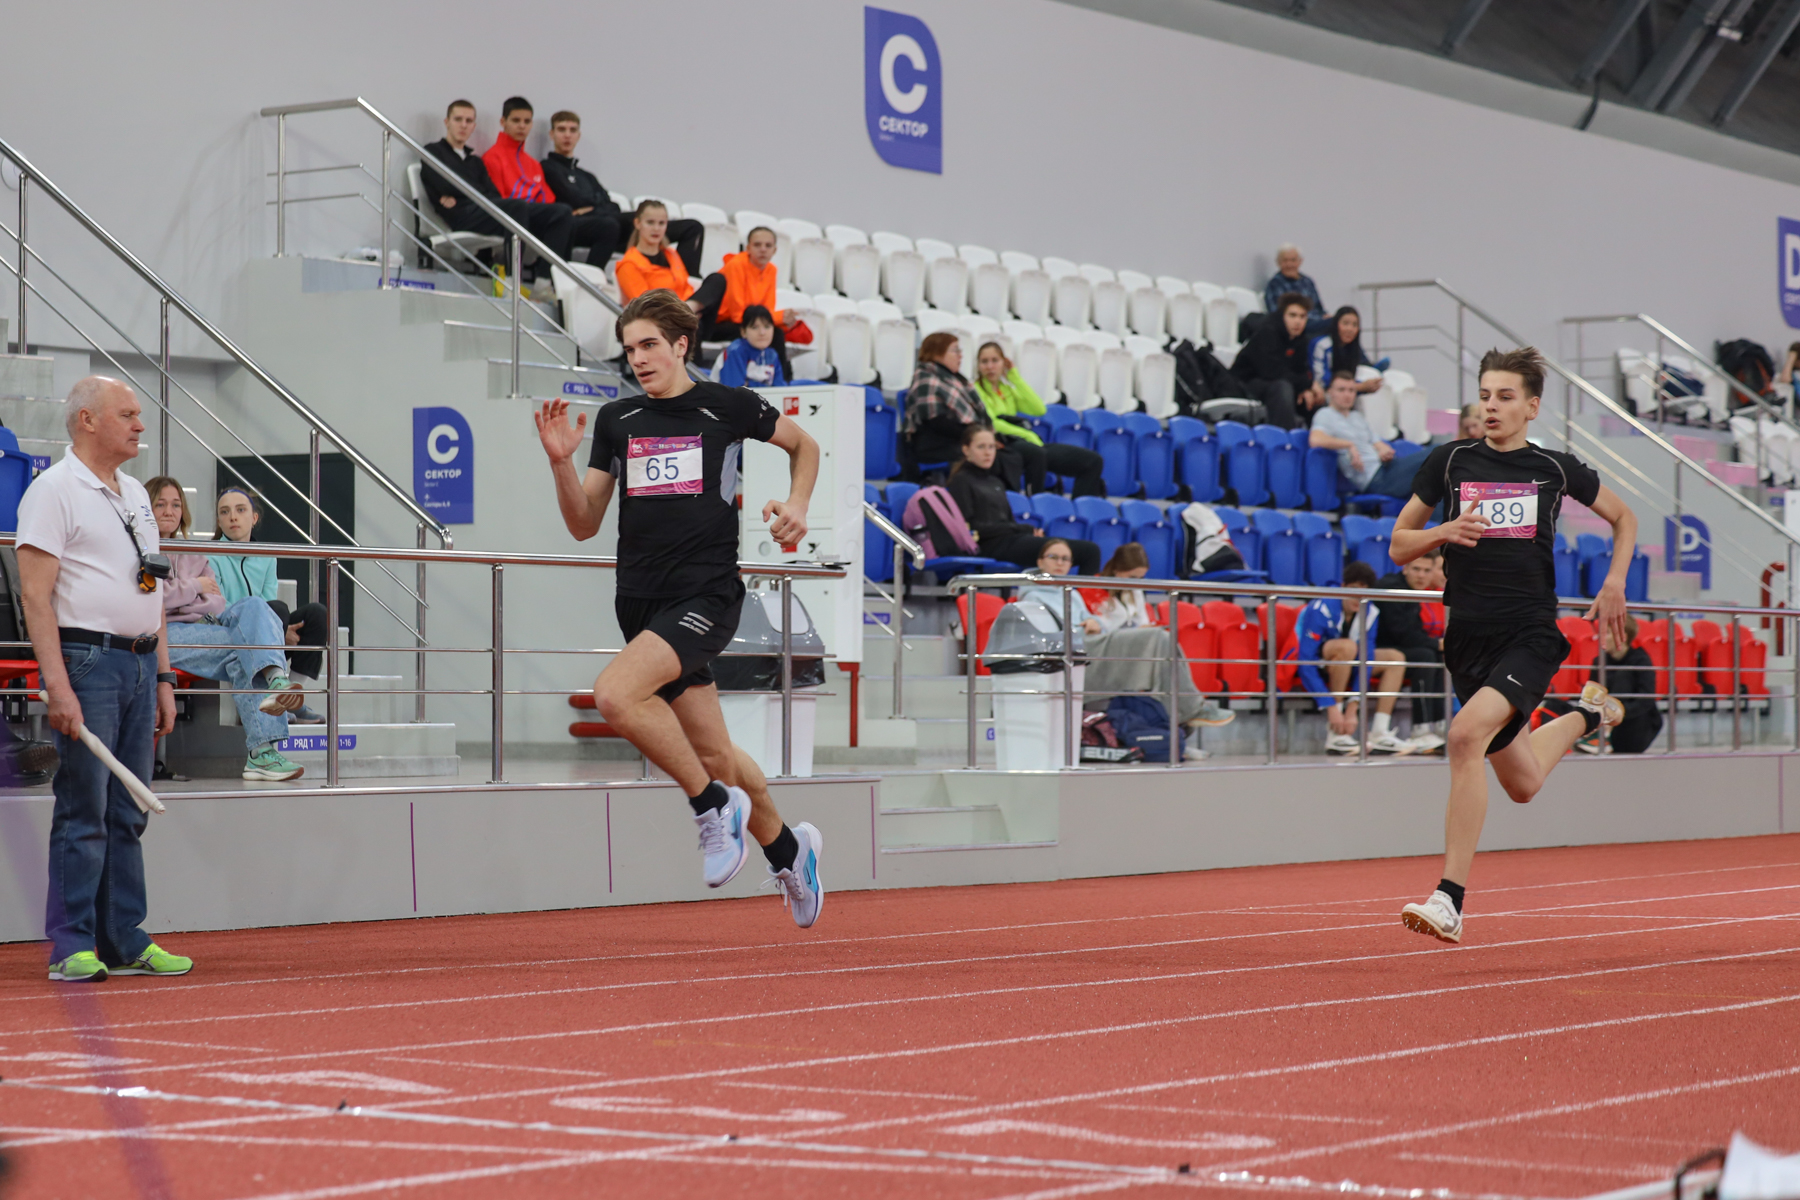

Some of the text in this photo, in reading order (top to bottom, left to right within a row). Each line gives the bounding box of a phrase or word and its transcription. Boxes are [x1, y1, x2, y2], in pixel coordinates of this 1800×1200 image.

[880, 33, 928, 114] C
[879, 115, 928, 137] СЕКТОР
[427, 423, 459, 465] C
[425, 468, 462, 480] СЕКТОР
[646, 456, 679, 481] 65
[1477, 501, 1524, 525] 189
[1679, 526, 1700, 552] D
[294, 738, 308, 750] РЯД
[309, 738, 314, 748] 1
